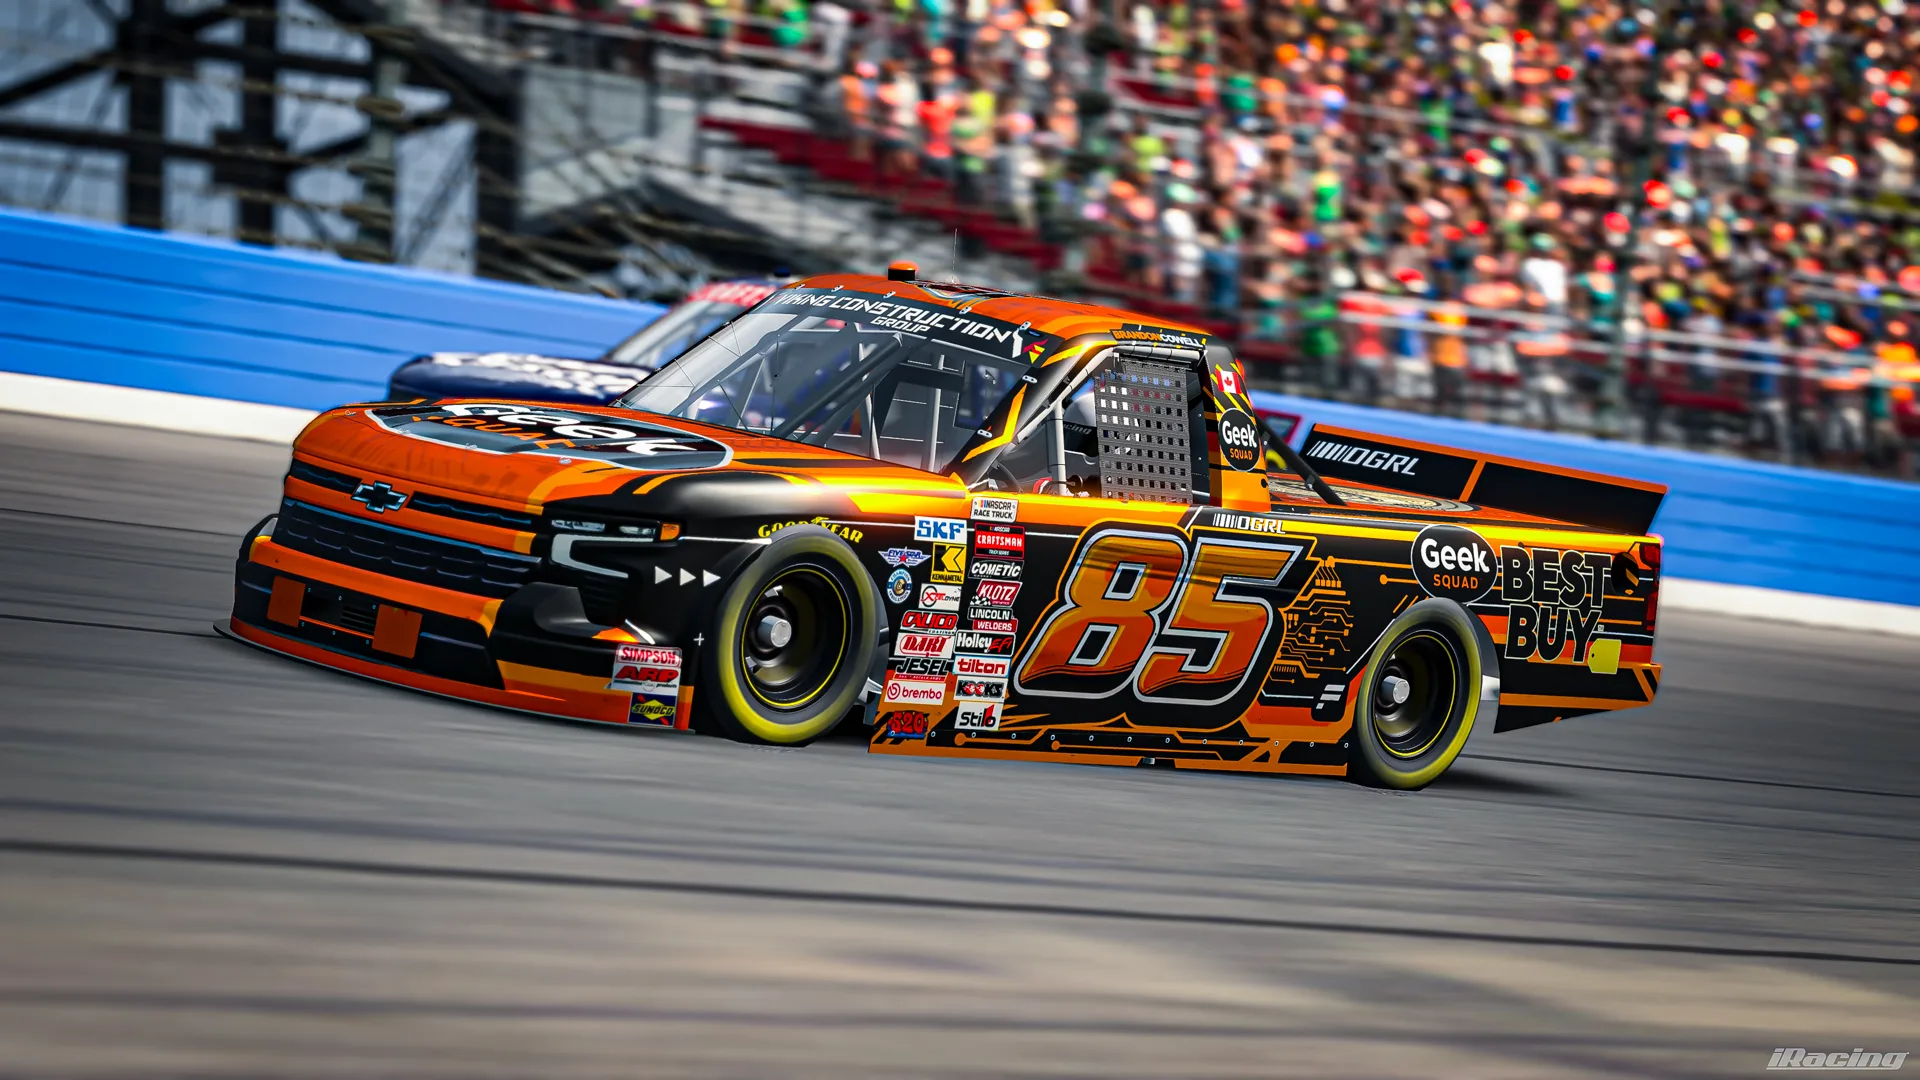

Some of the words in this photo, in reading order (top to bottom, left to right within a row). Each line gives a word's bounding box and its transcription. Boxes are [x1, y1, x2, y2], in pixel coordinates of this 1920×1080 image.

[774, 292, 833, 308] VIKING
[828, 295, 1012, 344] CONSTRUCTION
[871, 315, 931, 333] GROUP
[1221, 420, 1258, 449] Geek
[1229, 448, 1254, 461] SQUAD
[973, 509, 990, 518] RACE
[992, 510, 1013, 519] TRUCK
[986, 500, 1012, 511] NASCAR
[916, 519, 965, 540] SKF
[977, 534, 1022, 548] CRAFTSMAN
[887, 549, 905, 557] FIVE
[905, 550, 922, 559] STAR
[1420, 537, 1490, 574] Geek
[931, 573, 963, 583] KENNAMETAL
[971, 561, 1021, 578] COMETIC
[1500, 545, 1612, 608] BEST
[1432, 573, 1479, 590] SQUAD
[978, 584, 1017, 601] KLOTZ
[901, 611, 959, 630] CALICO
[969, 608, 1011, 620] LINCOLN
[1013, 528, 1304, 707] 85
[977, 621, 1013, 631] WELDERS
[1504, 603, 1602, 663] BUY
[902, 635, 952, 653] DART
[956, 632, 993, 653] Holley
[621, 647, 676, 664] SIMPSON
[615, 666, 679, 682] ARP
[895, 656, 950, 675] JESEL
[957, 658, 1006, 675] tilton
[901, 686, 942, 700] brembo
[632, 703, 675, 715] SUNOCO
[959, 704, 997, 728] Stilo
